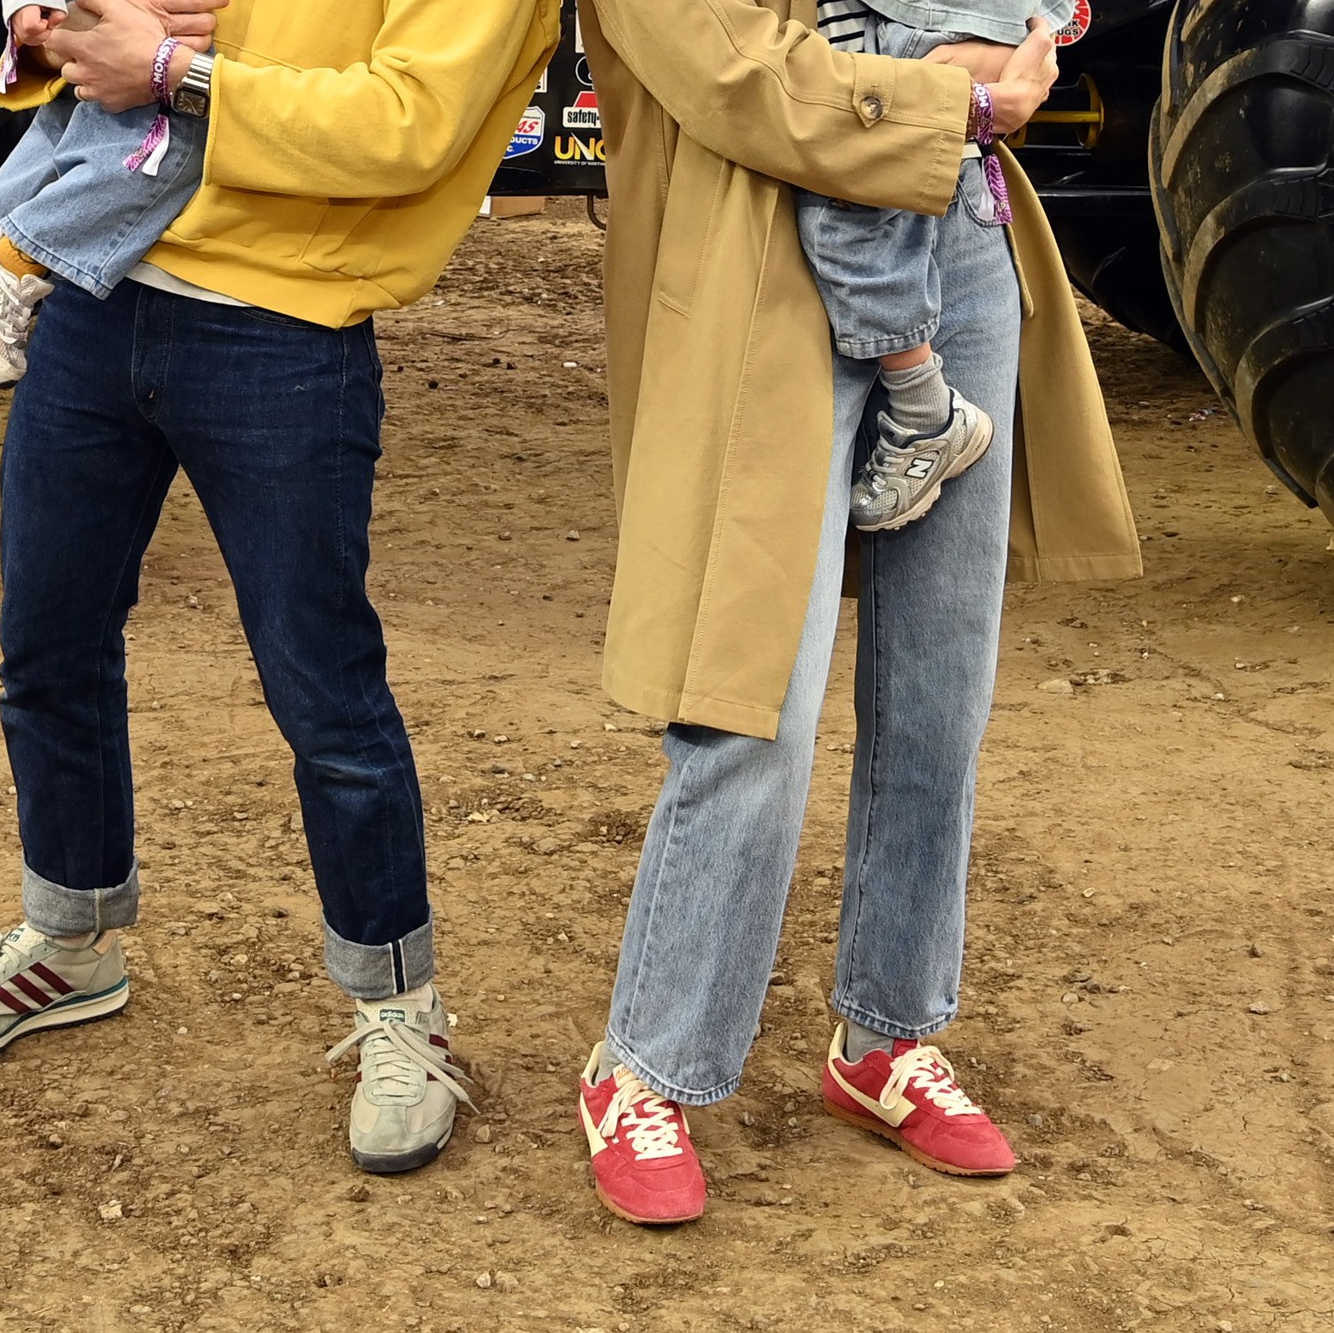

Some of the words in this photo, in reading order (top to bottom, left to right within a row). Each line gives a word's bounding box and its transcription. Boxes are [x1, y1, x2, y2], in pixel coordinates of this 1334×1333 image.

[1057, 28, 1079, 36] UGS
[153, 37, 177, 83] MONST
[567, 109, 600, 126] safety-
